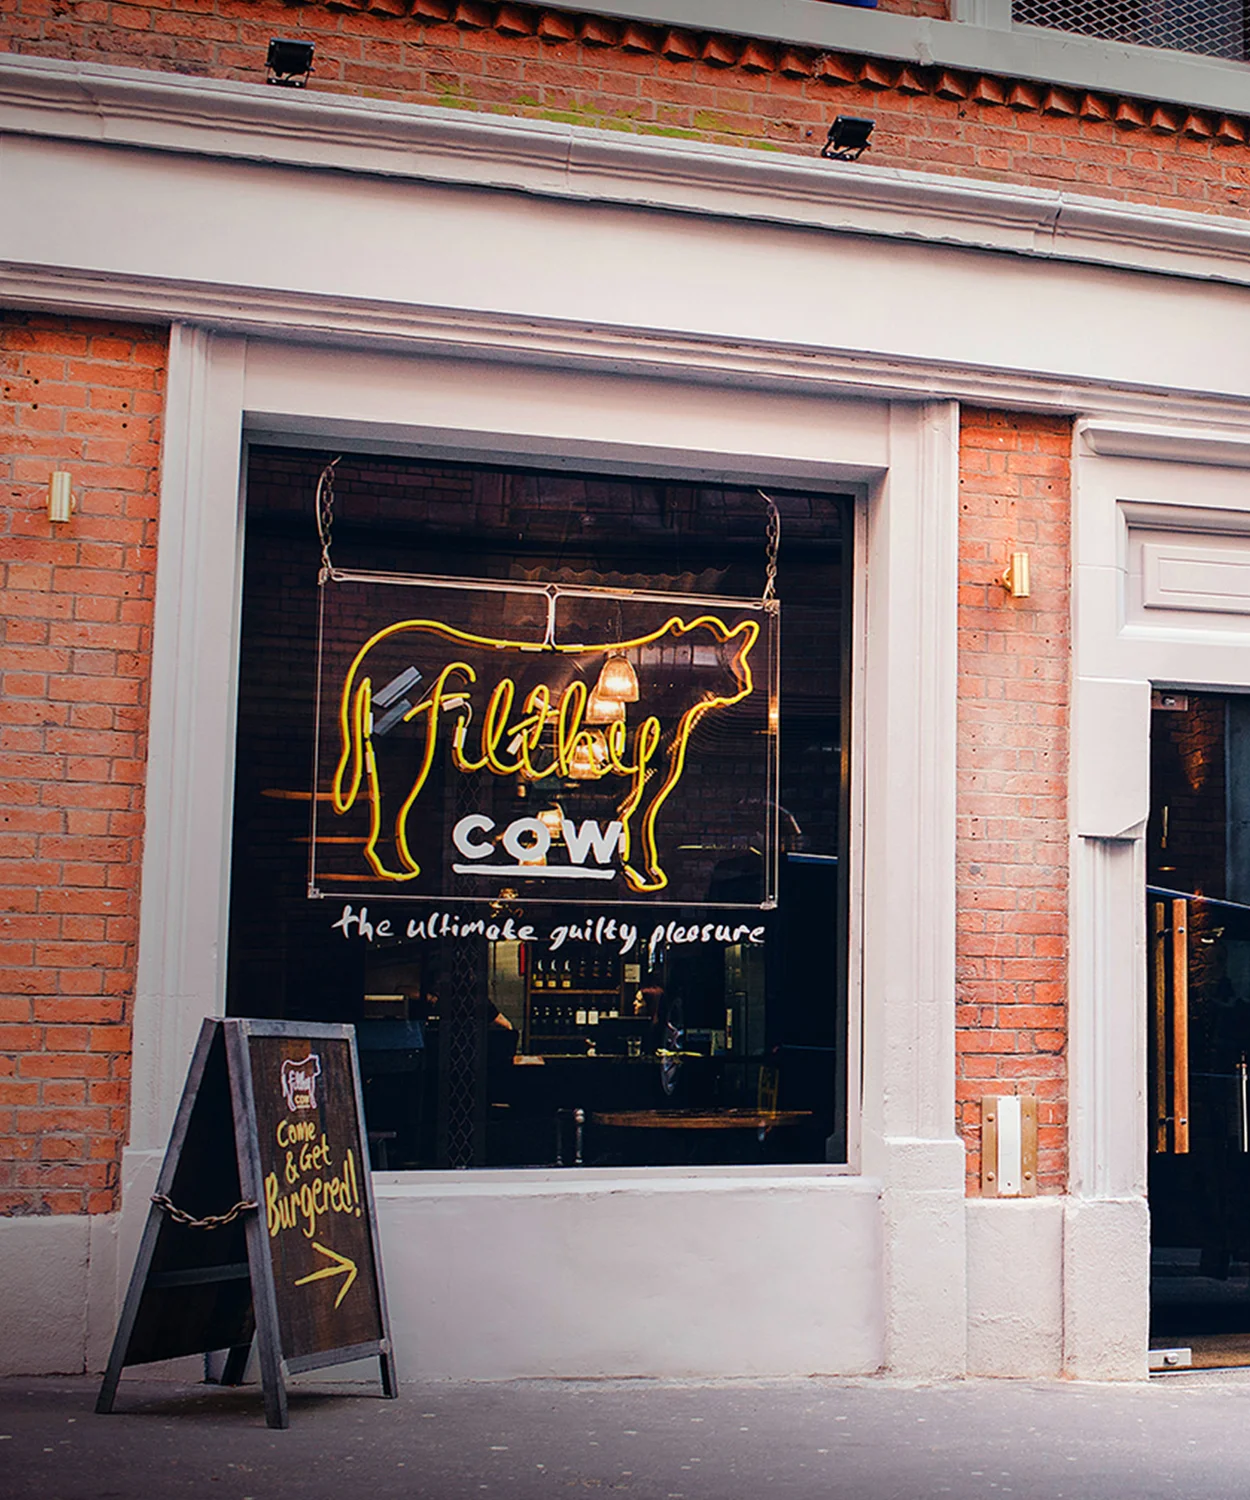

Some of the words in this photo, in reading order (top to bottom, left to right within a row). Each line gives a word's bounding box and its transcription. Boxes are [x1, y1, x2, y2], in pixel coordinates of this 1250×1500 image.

[403, 662, 662, 780] filthy
[452, 813, 624, 865] COW
[331, 904, 395, 941] the
[406, 912, 538, 941] ultimate
[549, 916, 637, 956] guilty
[649, 917, 766, 949] pleasure
[277, 1119, 316, 1148] Come
[285, 1150, 300, 1184] &
[299, 1132, 333, 1172] Get
[264, 1148, 361, 1238] Burgered!
